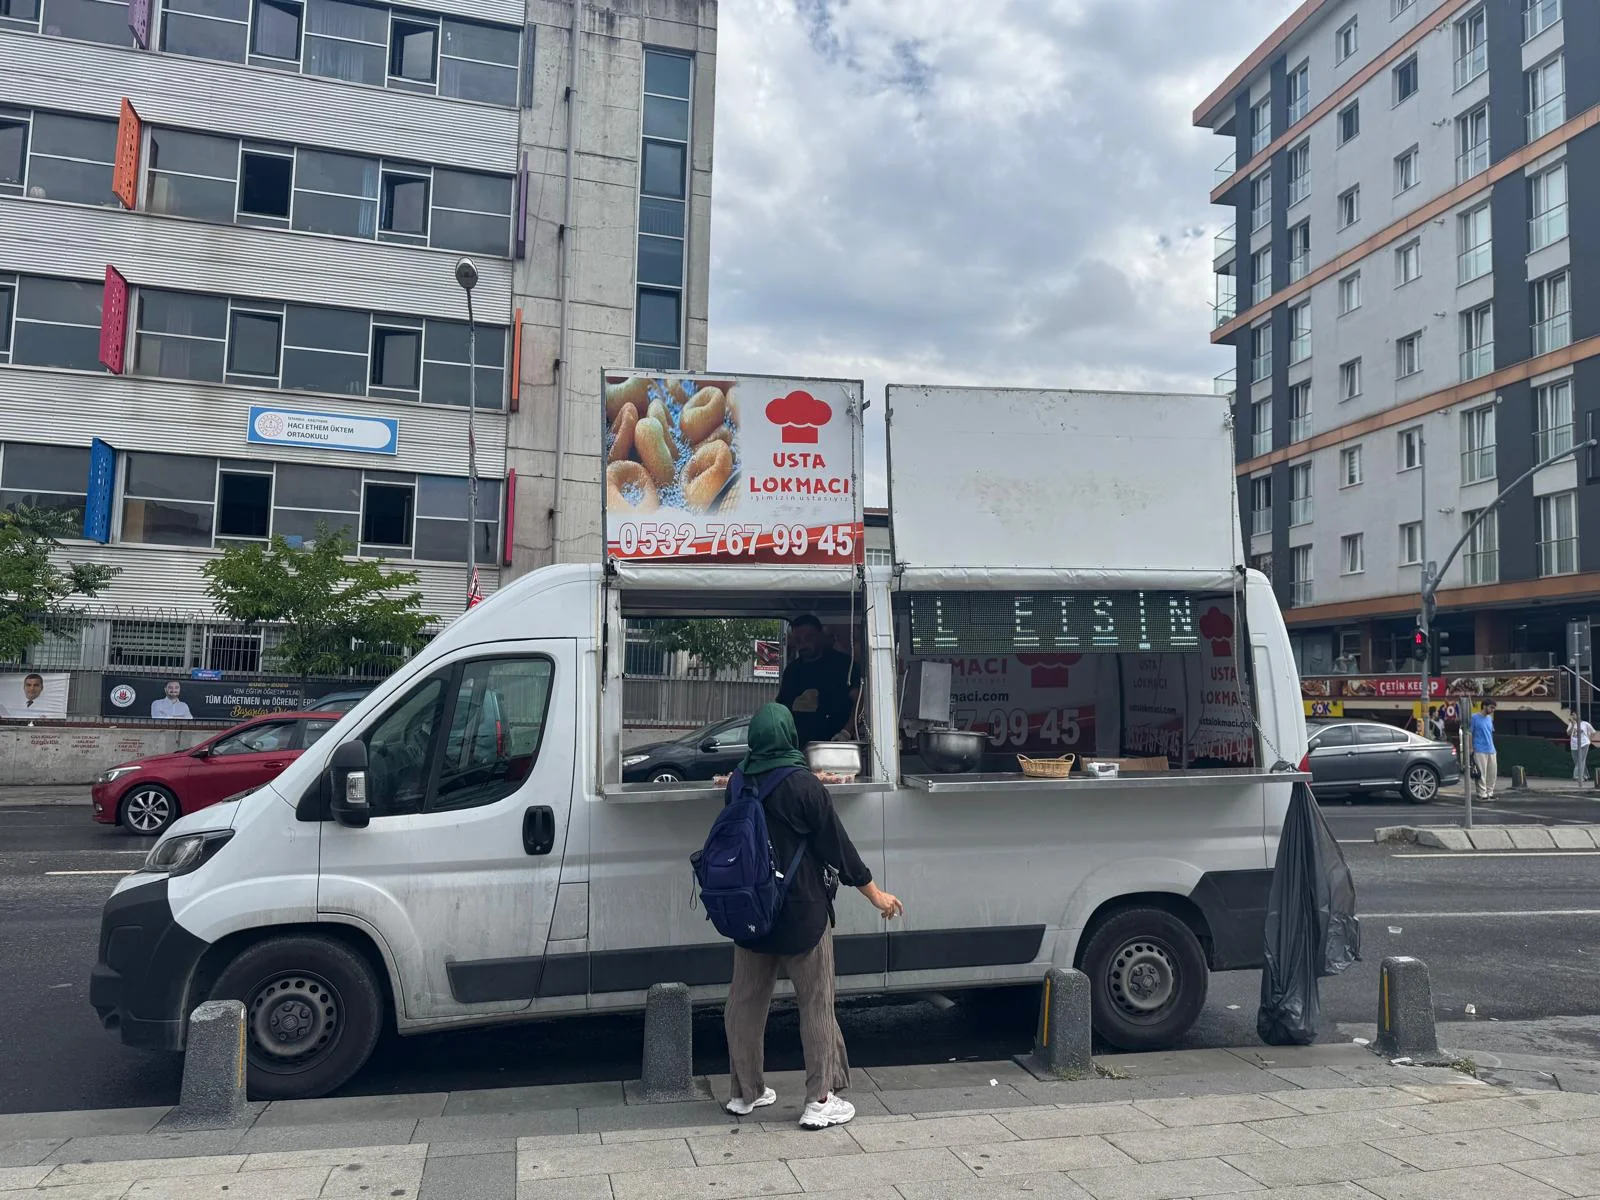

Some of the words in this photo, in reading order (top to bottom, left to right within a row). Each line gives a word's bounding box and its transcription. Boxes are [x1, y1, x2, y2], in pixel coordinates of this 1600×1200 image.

[286, 431, 329, 440] ORTAOKULU
[330, 425, 354, 434] ÜKTEM
[773, 452, 826, 469] USTA
[749, 477, 849, 494] LOKMACI
[619, 522, 697, 556] 0532
[706, 523, 763, 556] 767
[772, 524, 809, 556] 99
[817, 525, 853, 556] 45
[1210, 666, 1238, 681] USTA
[1380, 680, 1406, 696] ÇETİN
[1407, 681, 1439, 695] KEBP
[205, 695, 221, 704] TÜM
[222, 695, 260, 706] ÖĞRETMEN
[950, 690, 1009, 702] maci.com
[1040, 709, 1081, 746] 45
